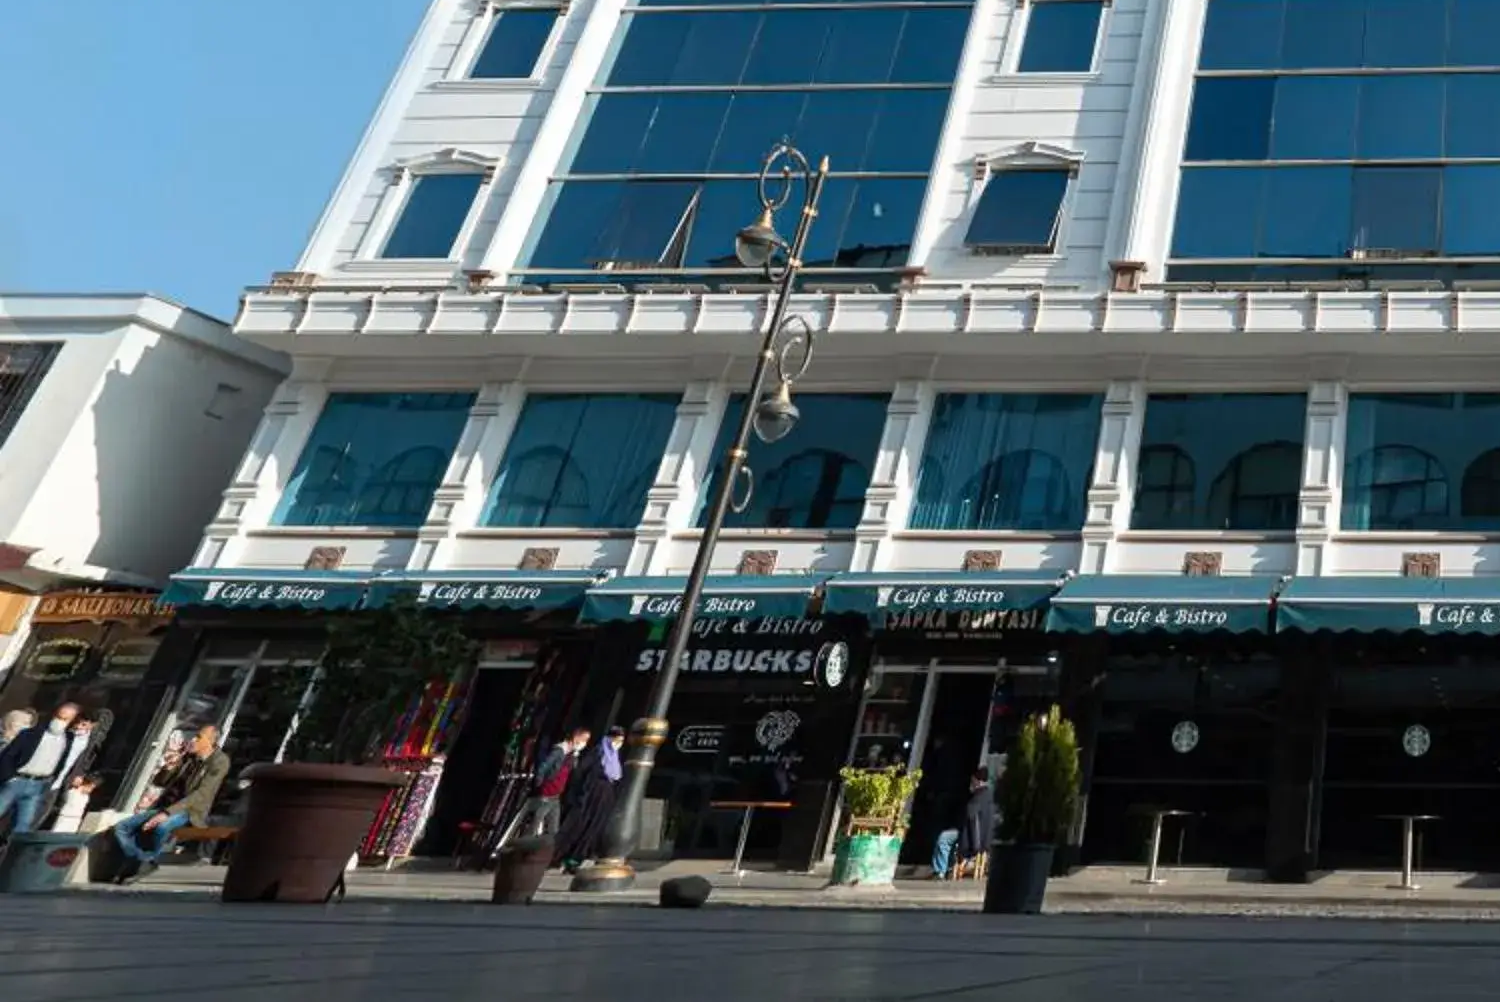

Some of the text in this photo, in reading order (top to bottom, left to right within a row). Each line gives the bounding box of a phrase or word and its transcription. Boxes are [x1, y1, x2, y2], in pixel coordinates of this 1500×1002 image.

[220, 582, 325, 605] Cafe & Bistro
[435, 582, 542, 605] Cafe & Bistro
[703, 597, 756, 614] Bistro
[893, 585, 1004, 609] Cafe & Bistro
[692, 614, 823, 639] afe & Bistro
[1113, 605, 1228, 629] Cafe & Bistro
[1436, 605, 1475, 629] Cafe
[1480, 607, 1495, 623] &
